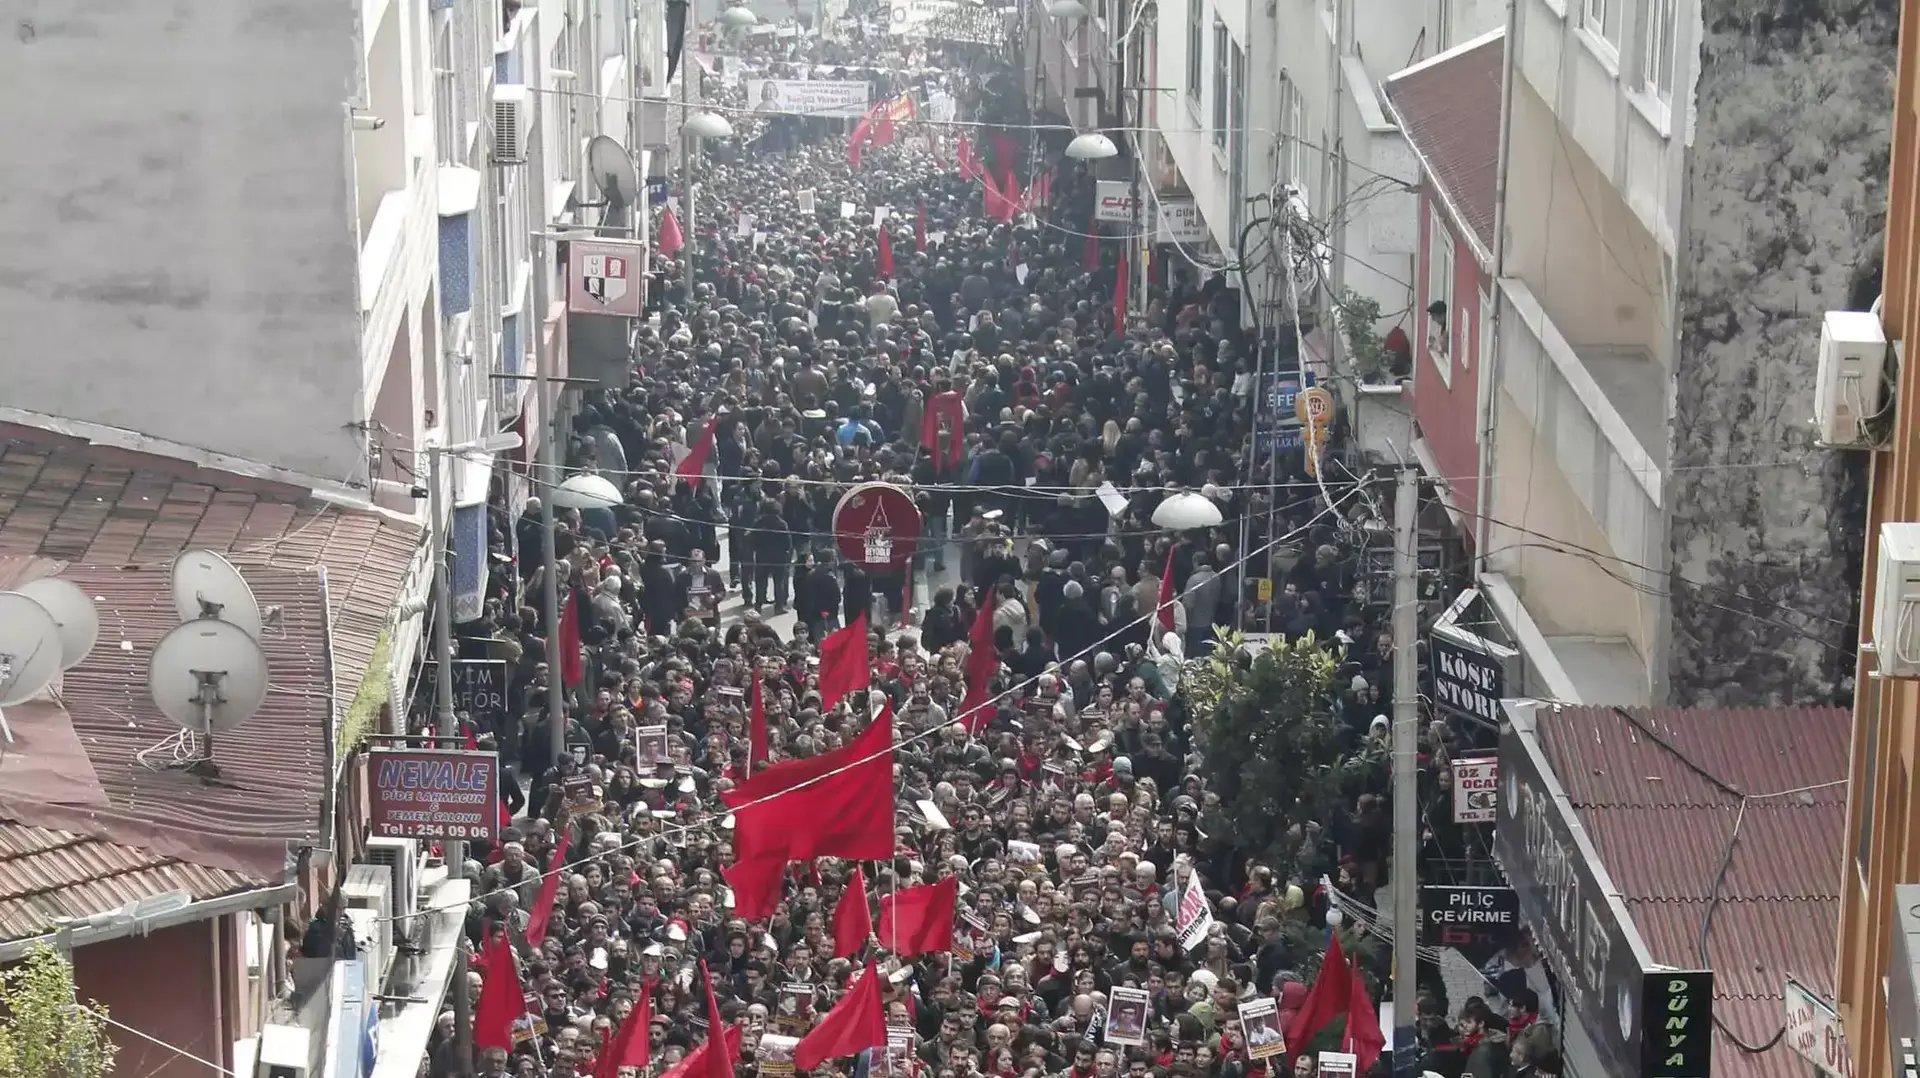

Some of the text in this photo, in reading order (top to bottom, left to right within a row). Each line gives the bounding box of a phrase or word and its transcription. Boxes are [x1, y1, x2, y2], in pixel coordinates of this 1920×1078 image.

[1266, 393, 1294, 408] EFE
[1440, 651, 1495, 692] KÖŞE
[378, 760, 490, 791] NEVALE
[1459, 767, 1479, 779] ÖZ
[1463, 779, 1497, 789] OCA
[382, 789, 486, 804] PİDE LAHMACUN
[429, 802, 440, 813] &
[387, 810, 481, 823] YEMEK SALONU
[417, 825, 444, 837] 254
[449, 826, 466, 837] 09
[471, 827, 489, 838] 06
[1449, 891, 1494, 909] PİLİÇ
[1431, 908, 1512, 925] ÇEVİRME
[1665, 980, 1689, 1066] DÜNYA
